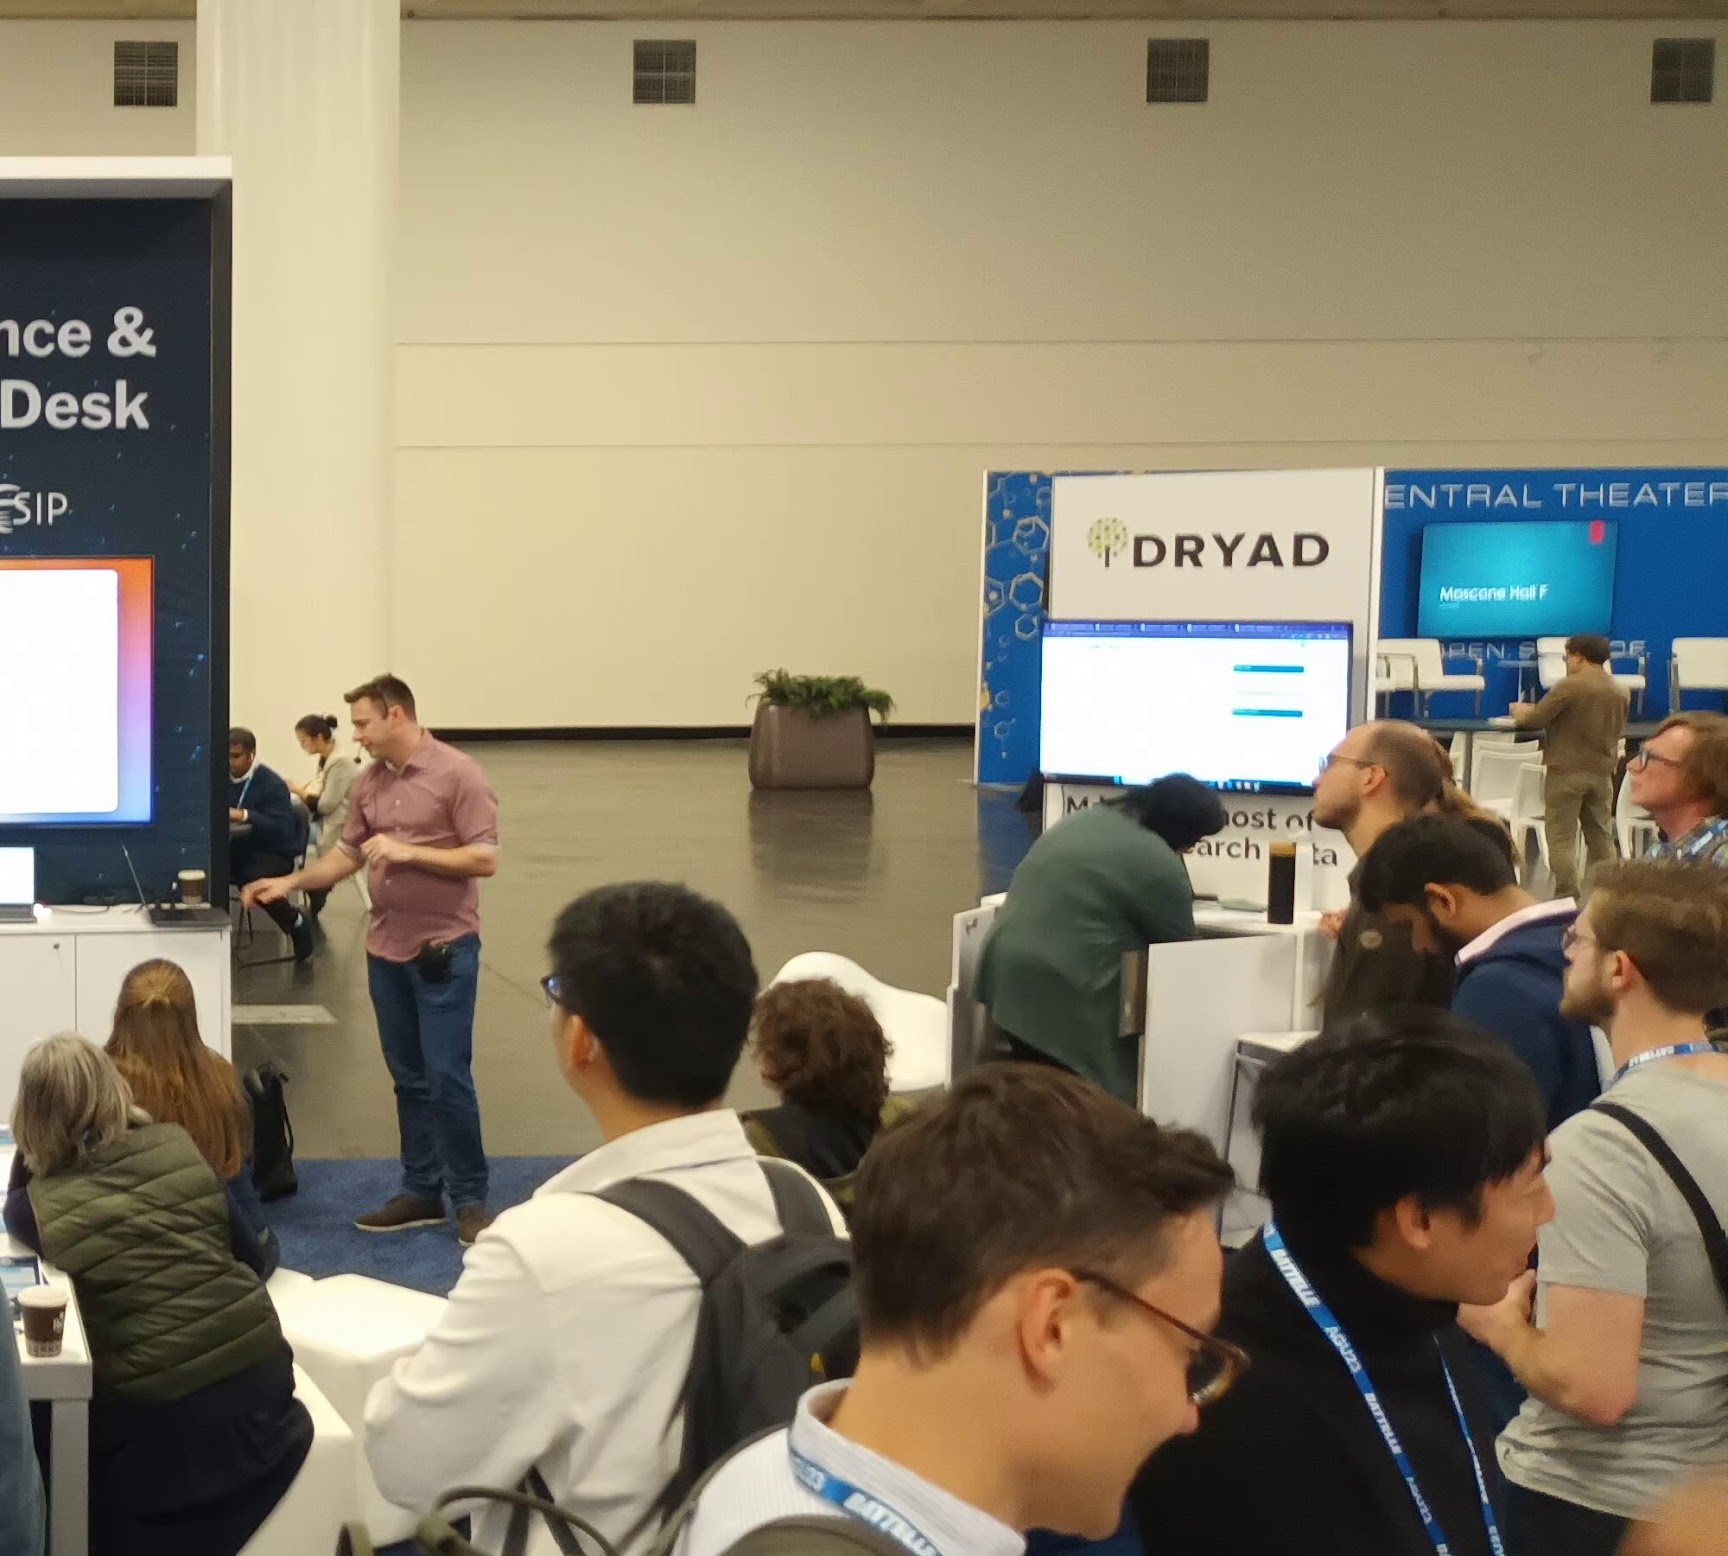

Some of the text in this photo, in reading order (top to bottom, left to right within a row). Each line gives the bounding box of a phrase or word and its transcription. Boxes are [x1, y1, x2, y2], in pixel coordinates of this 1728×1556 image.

[106, 305, 157, 358] &
[0, 378, 150, 430] Desk
[1384, 481, 1728, 508] ENTRAL THEATER
[1133, 532, 1330, 568] DRYAD
[1439, 584, 1549, 602] Moscone Hall F
[1194, 836, 1338, 866] arch ta
